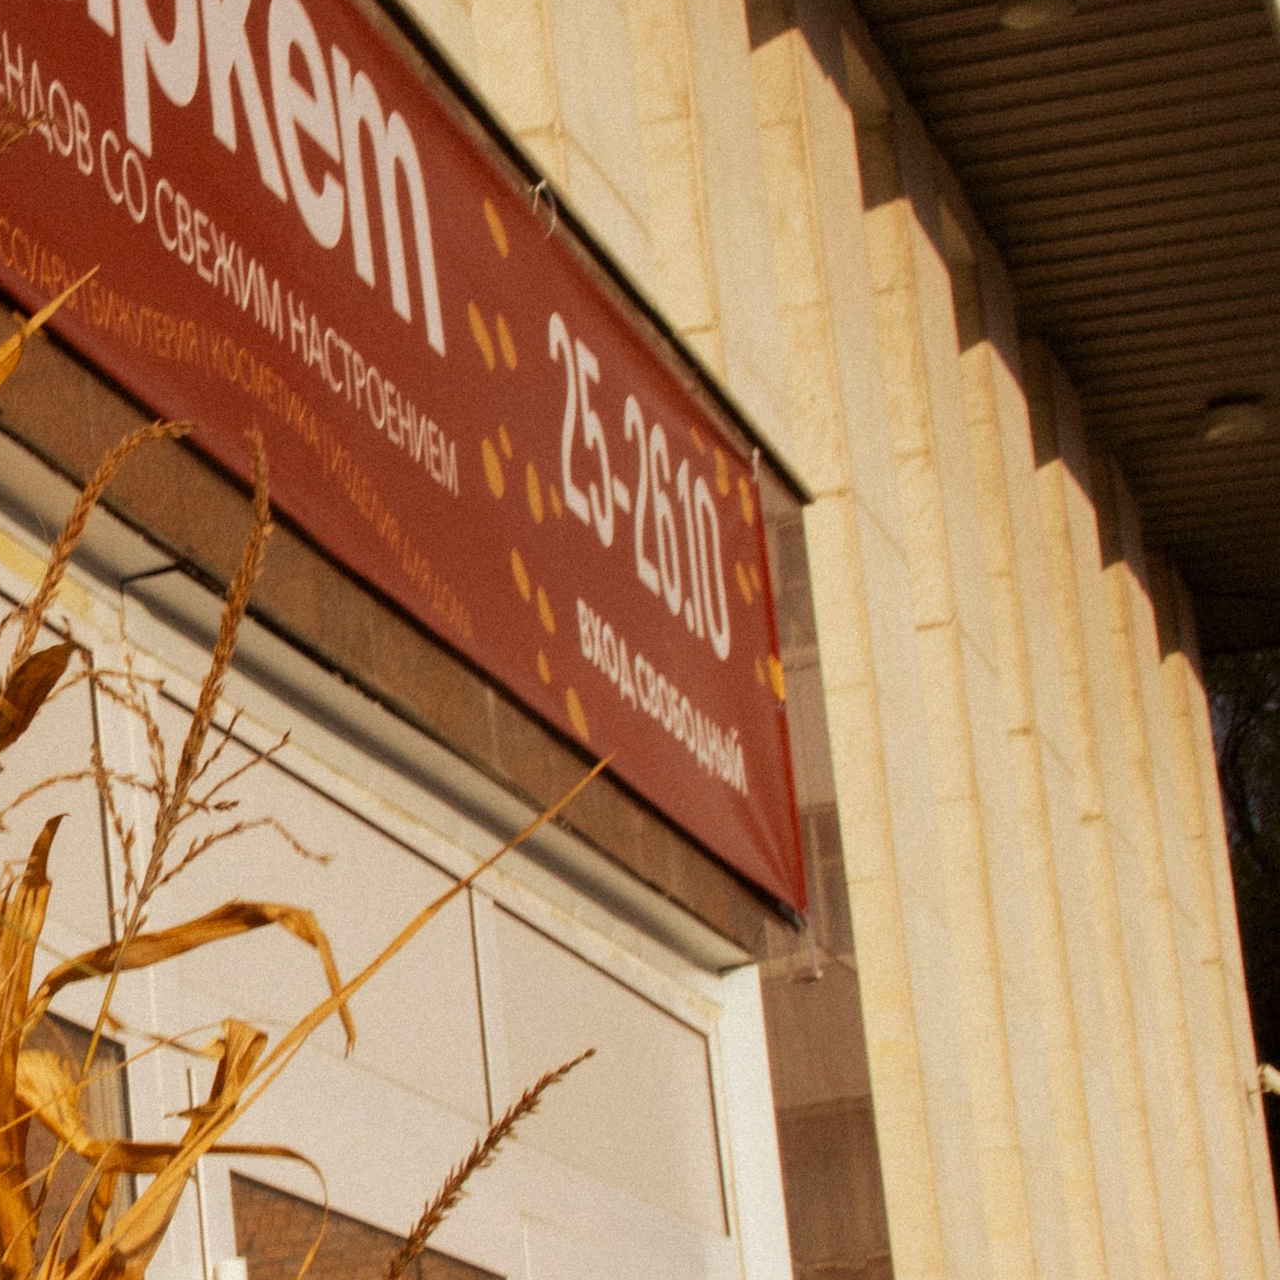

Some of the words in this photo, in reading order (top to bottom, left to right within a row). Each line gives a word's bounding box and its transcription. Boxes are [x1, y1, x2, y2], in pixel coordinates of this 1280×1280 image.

[89, 278, 200, 366] БИЖУТЕРИЯ
[211, 331, 320, 445] КОСМЕТИКА
[100, 129, 148, 223] СО
[154, 178, 284, 343] СВЕЖИМ
[287, 290, 459, 499] НАСТРОЕНИЕМ
[549, 312, 730, 661] 25-26.10
[577, 596, 639, 710] ВХОД
[632, 652, 749, 797] СВОБОДНЫЙ
